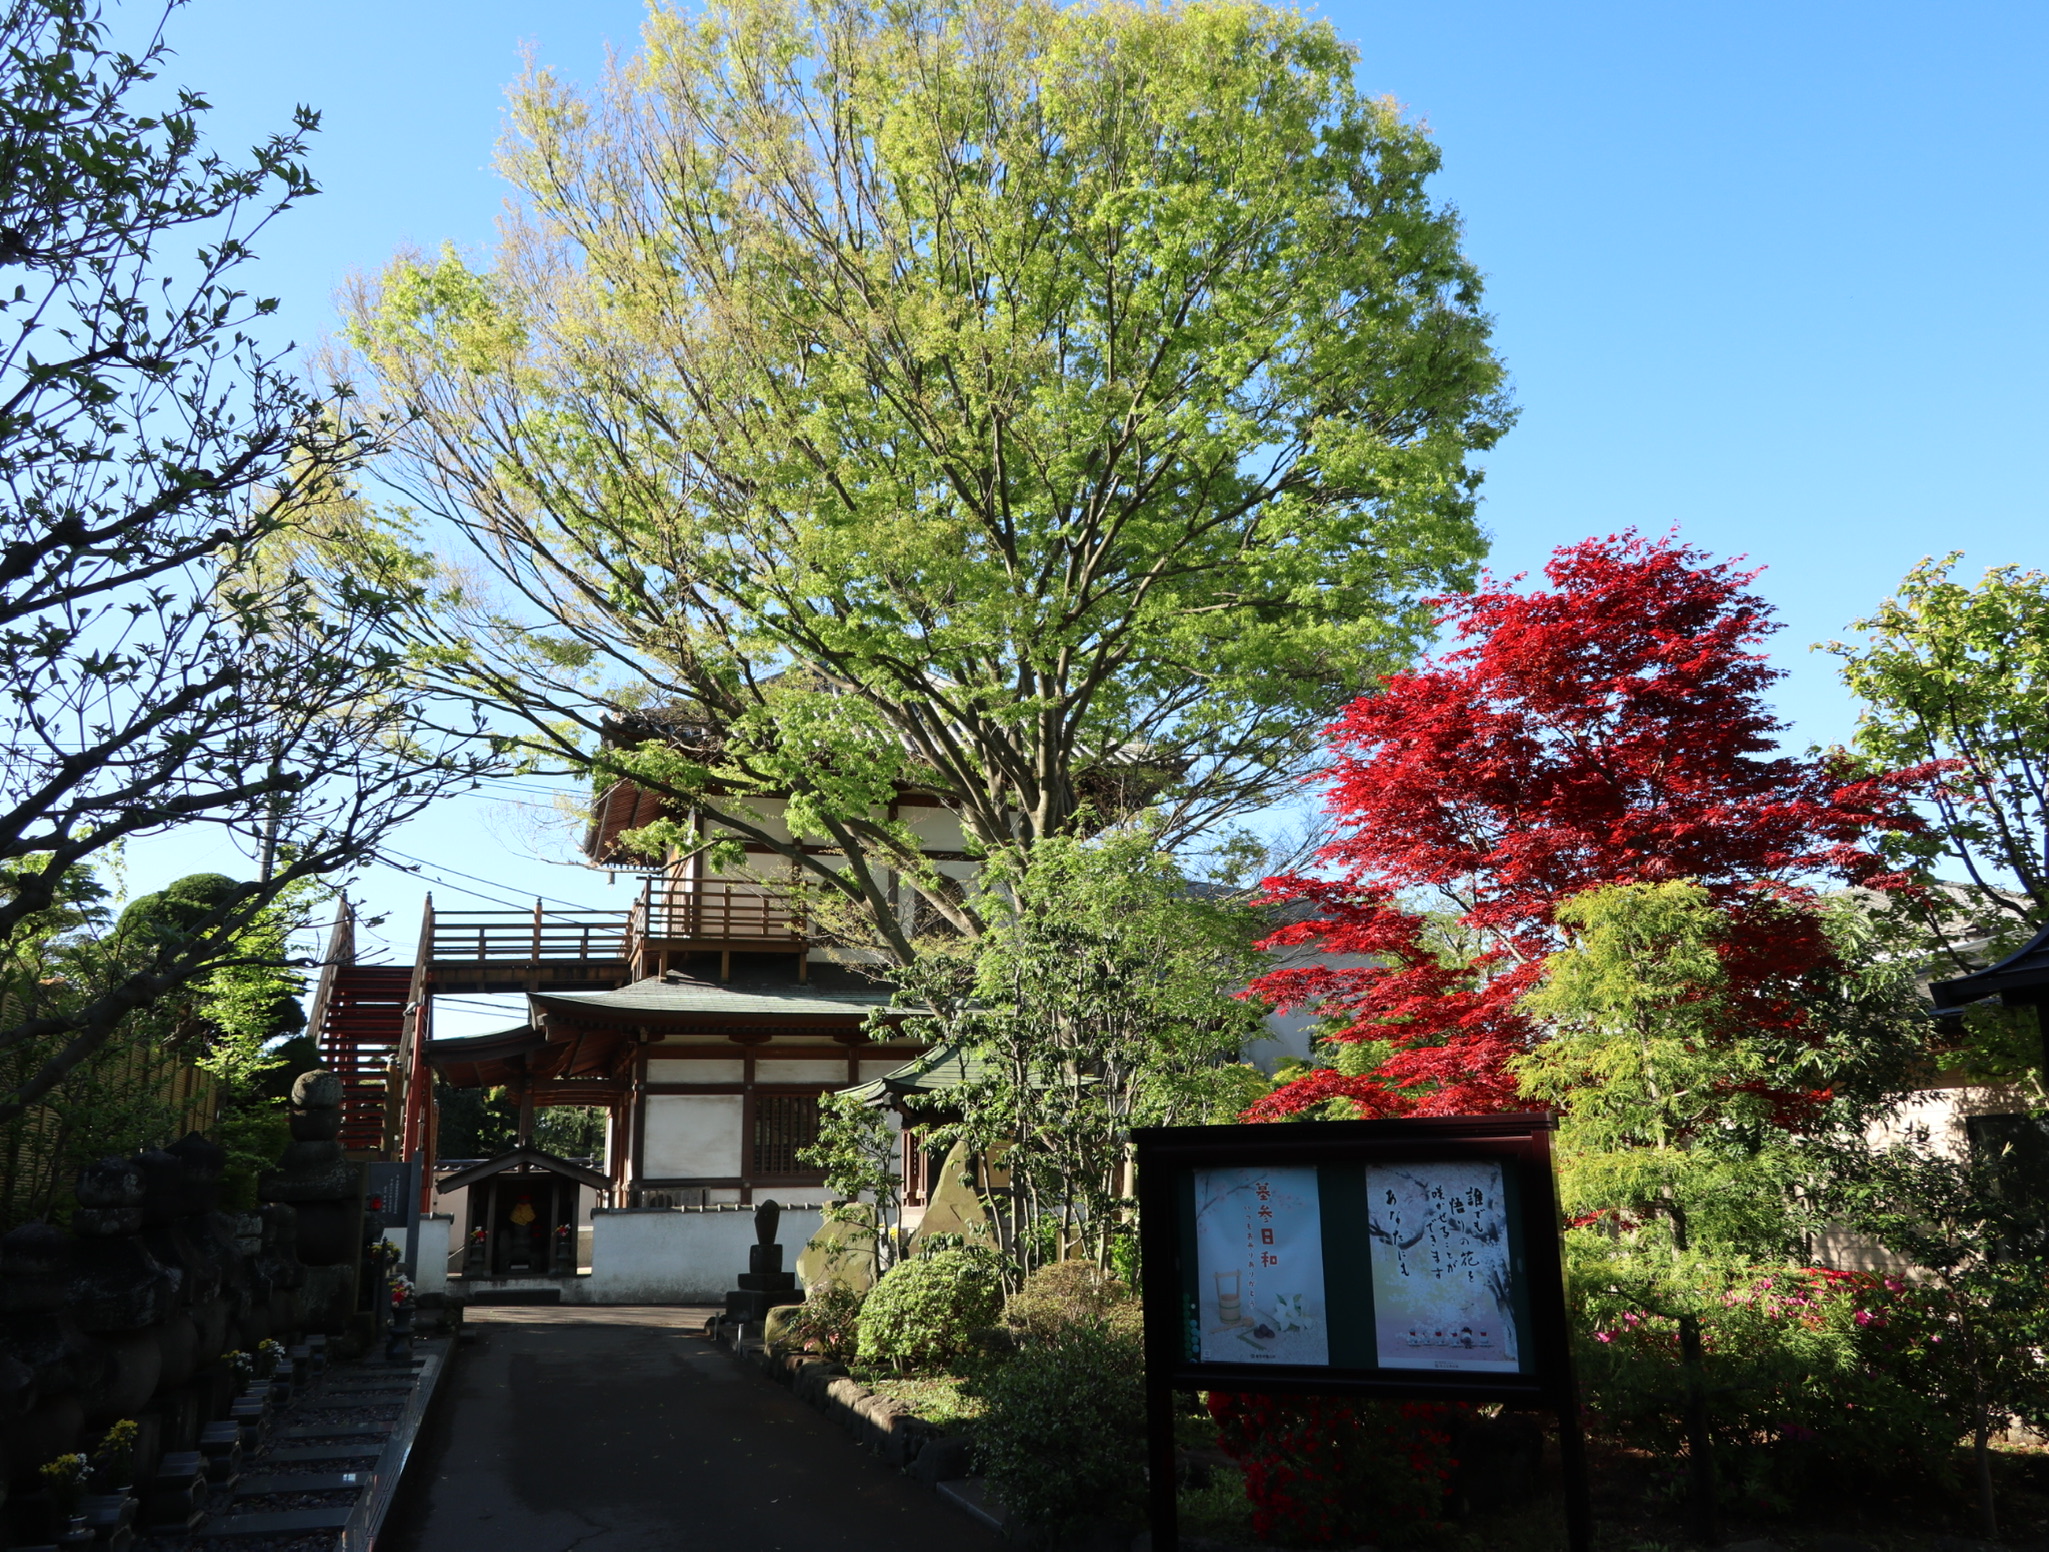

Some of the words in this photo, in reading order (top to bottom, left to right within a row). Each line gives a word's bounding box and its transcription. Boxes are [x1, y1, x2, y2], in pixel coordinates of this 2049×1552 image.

[1255, 1182, 1278, 1268] 墓参日和
[1385, 1189, 1410, 1277] あなたにも
[1426, 1218, 1444, 1280] できます
[1431, 1185, 1458, 1274] 咲かせることが
[1449, 1197, 1480, 1283] 悟りの花を
[1465, 1186, 1486, 1233] 誰でも
